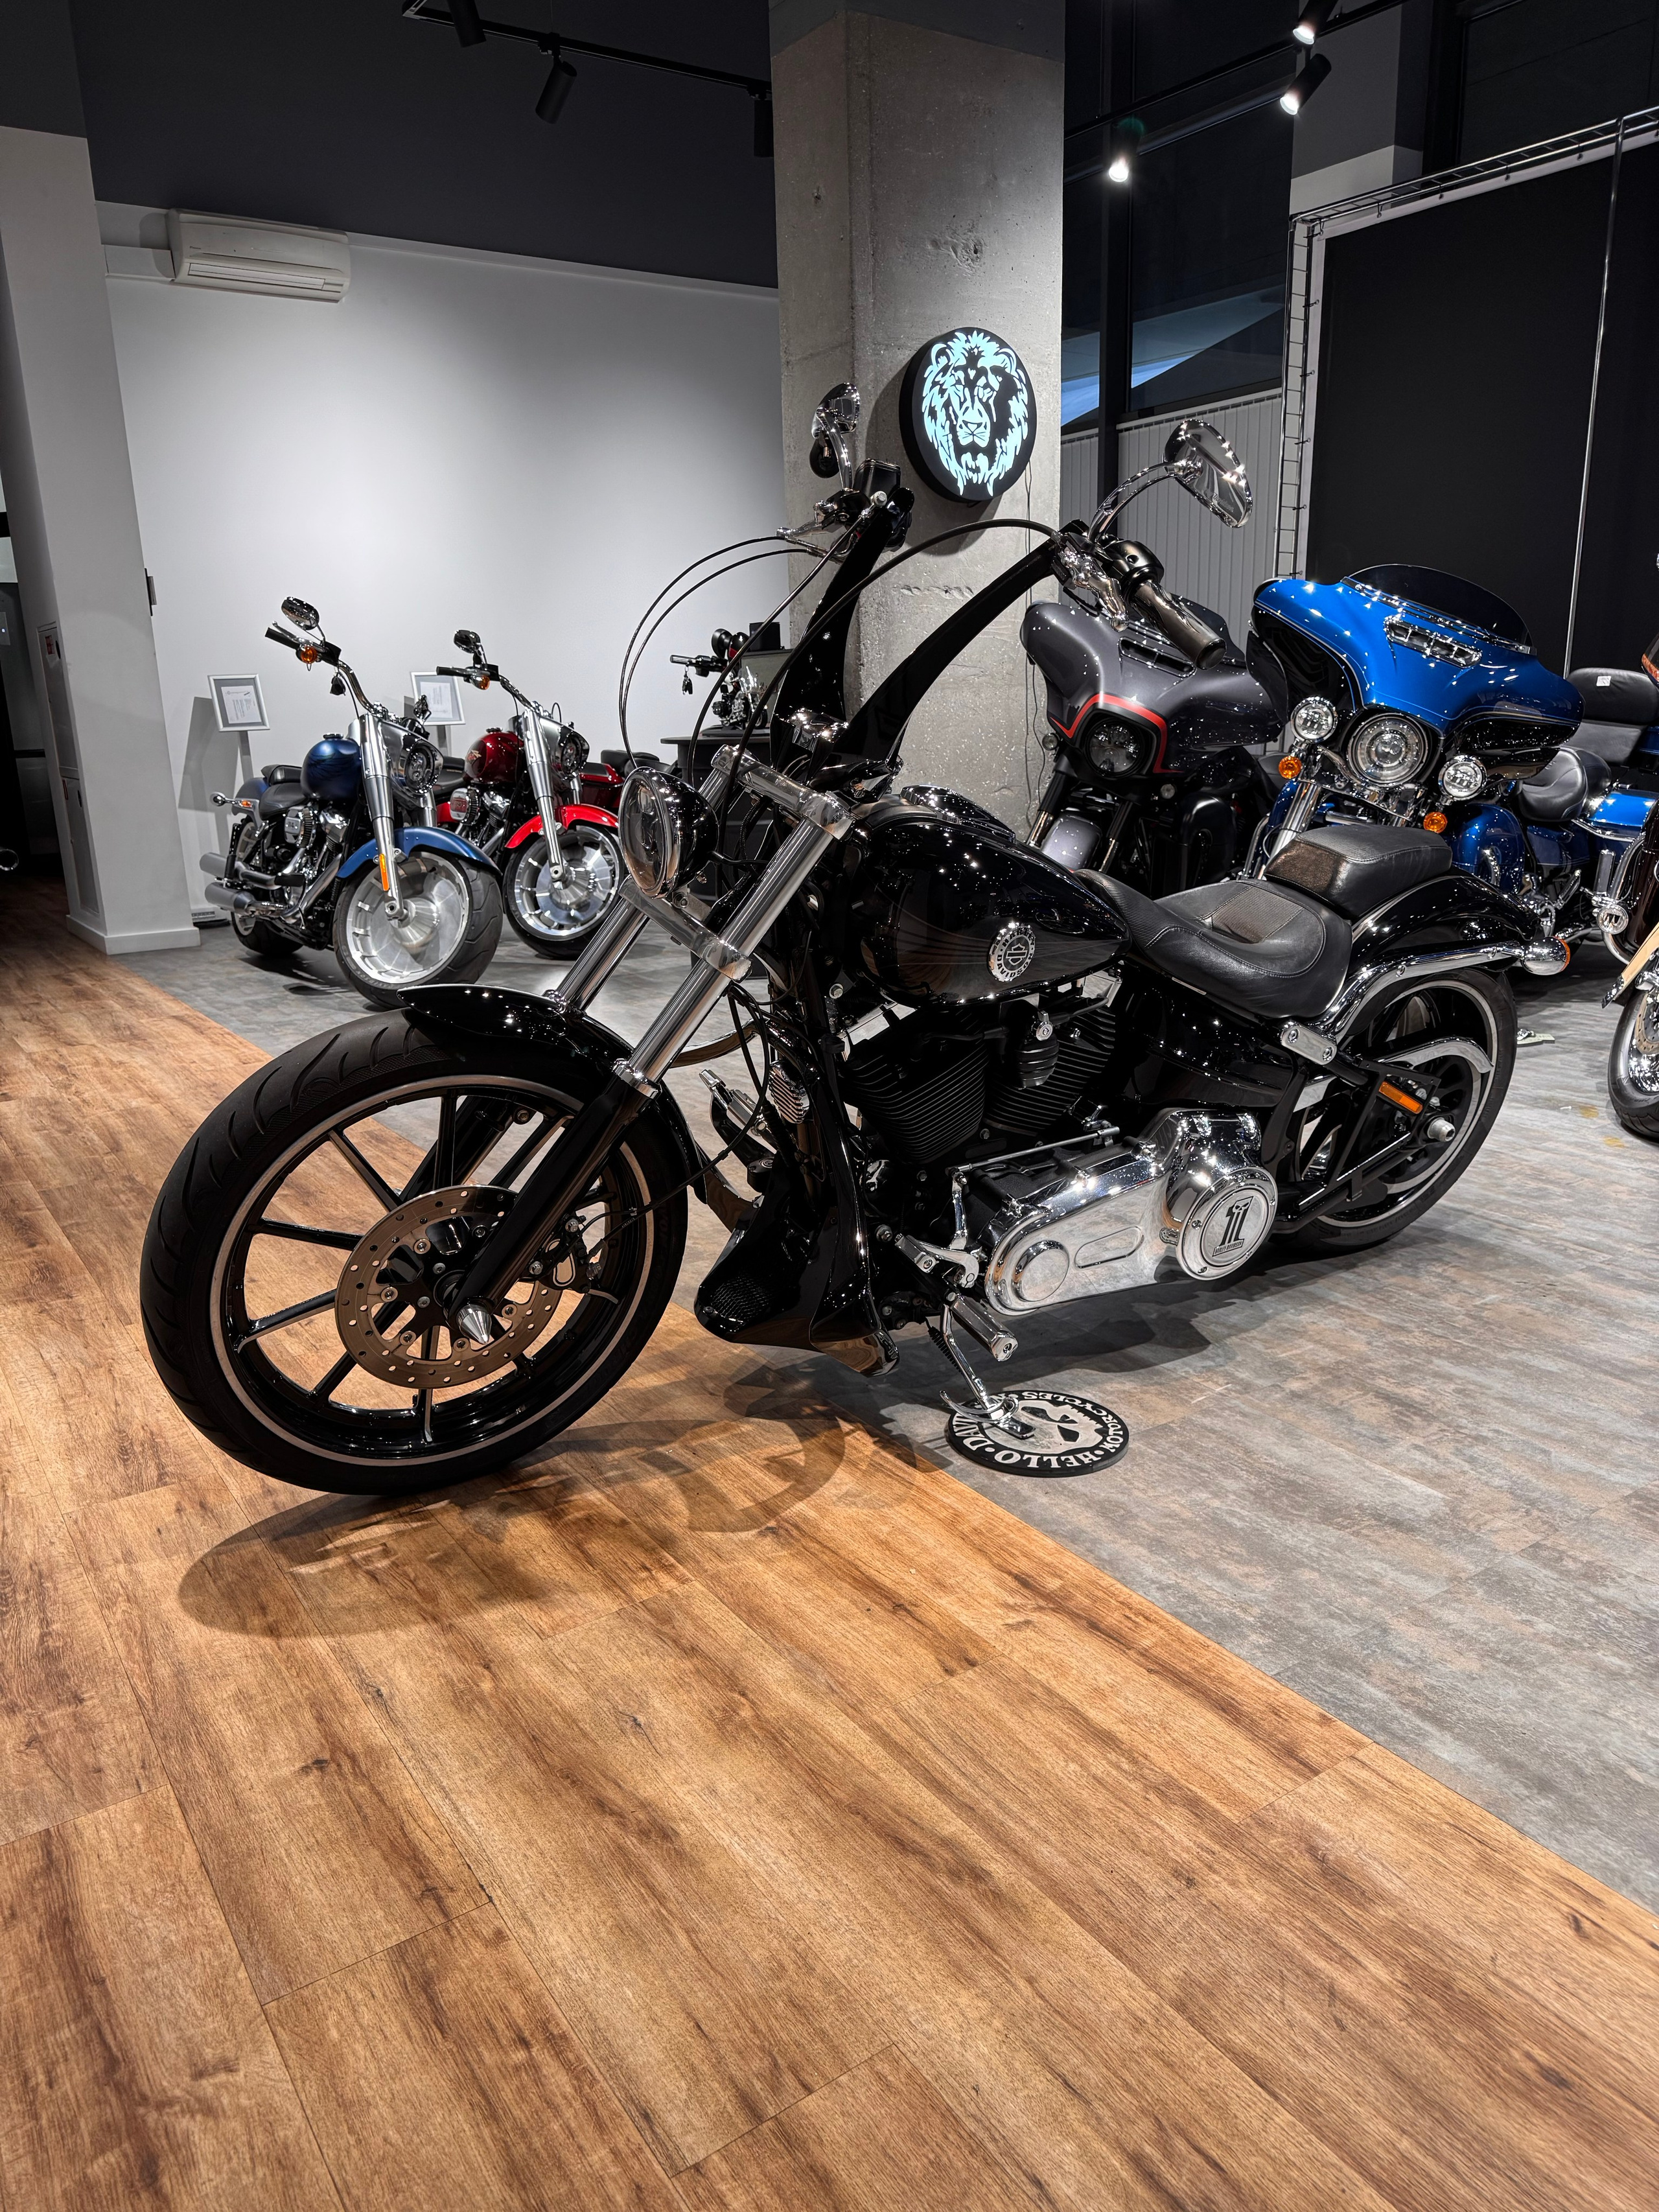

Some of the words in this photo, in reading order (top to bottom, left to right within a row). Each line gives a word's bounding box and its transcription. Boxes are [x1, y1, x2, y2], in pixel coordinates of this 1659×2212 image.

[1002, 927, 1034, 947] HARLEY
[997, 953, 1032, 977] DAVIDSON
[1021, 1391, 1124, 1452] MOTORCYCLES
[994, 1450, 1102, 1468] HELLO
